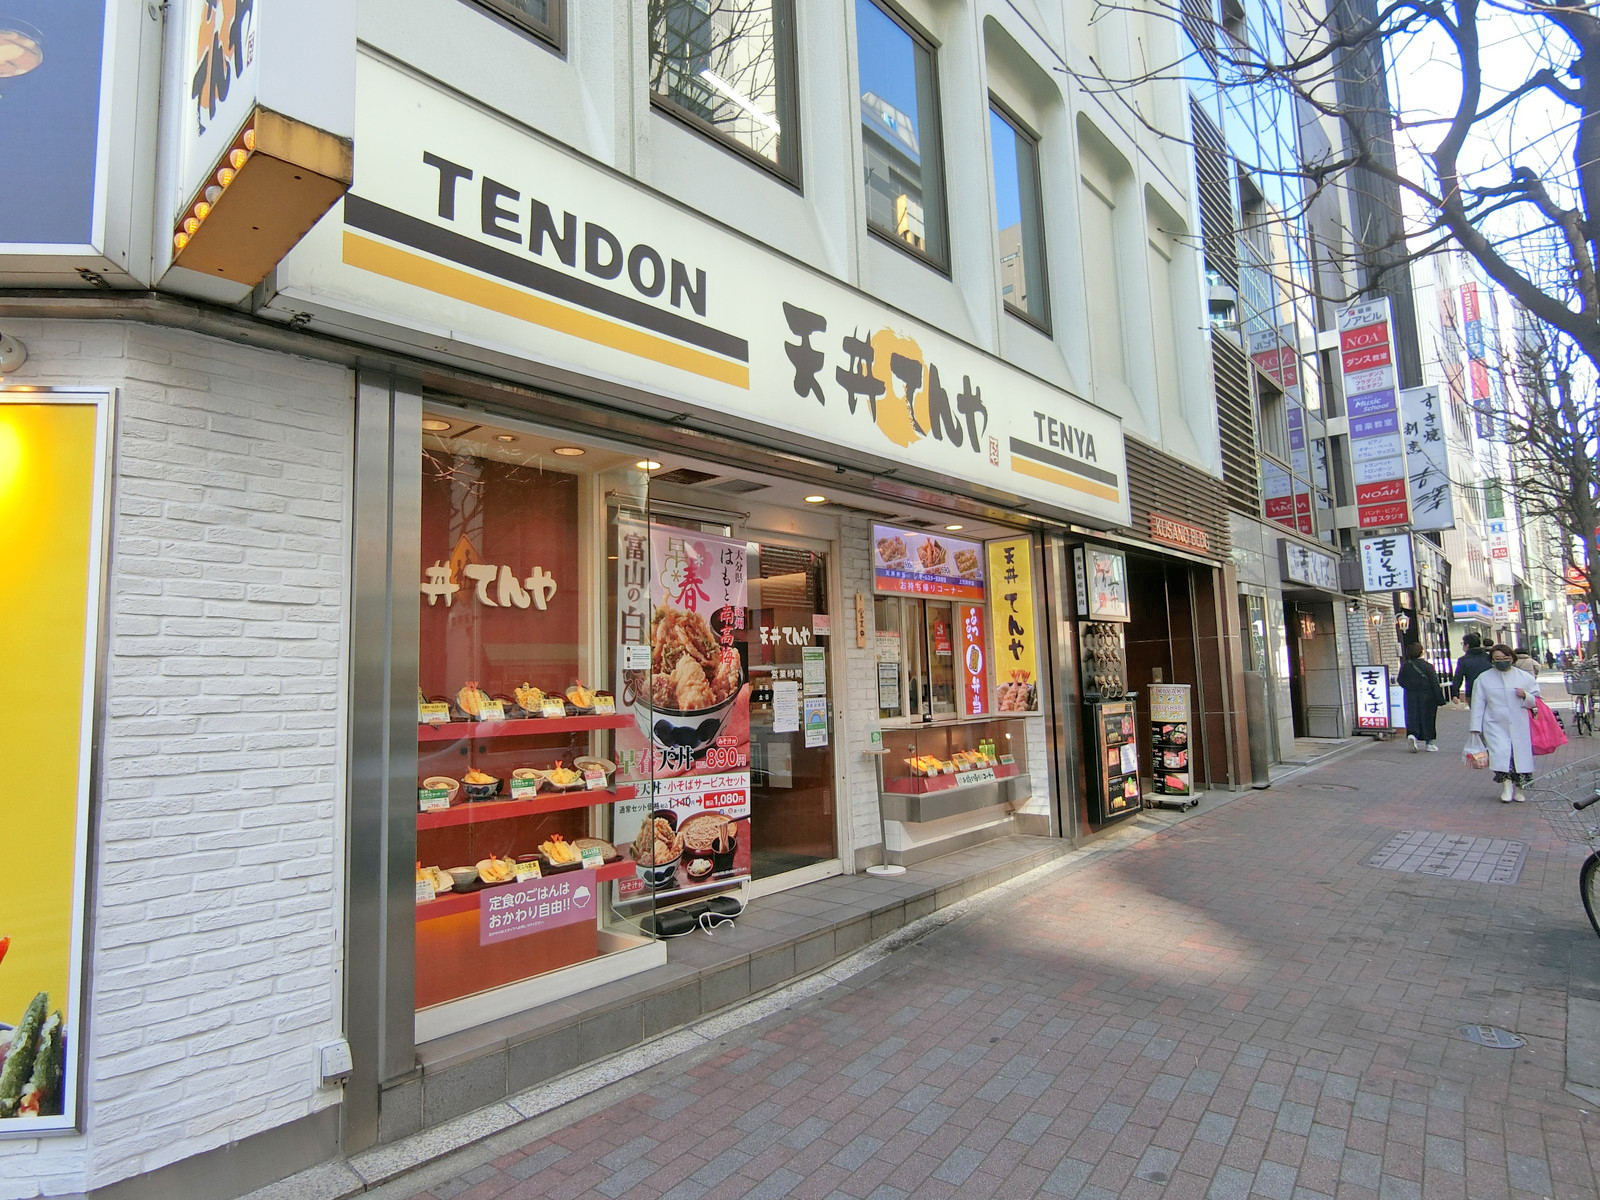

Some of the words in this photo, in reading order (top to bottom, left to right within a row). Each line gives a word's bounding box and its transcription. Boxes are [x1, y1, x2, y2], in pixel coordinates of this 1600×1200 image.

[423, 151, 707, 317] TENDON
[1343, 311, 1382, 328] ノアビル
[1346, 332, 1379, 349] NOA
[1346, 352, 1388, 367] ダンス教室
[1355, 397, 1382, 409] Music
[1363, 402, 1389, 413] School
[1033, 410, 1097, 463] TENYA
[1355, 418, 1394, 432] 音楽教室
[1155, 517, 1189, 544] KUSANO
[1363, 513, 1405, 524] 練習スタジオ
[719, 548, 735, 602] はもと
[1373, 539, 1402, 587] 吉そば
[899, 580, 964, 595] お持ち帰りコーナー
[719, 603, 736, 666] 南高梅
[971, 676, 984, 714] 弁当
[1361, 670, 1383, 714] 吉そば
[1361, 718, 1375, 727] 24
[619, 745, 695, 776] 早春天丼
[488, 881, 570, 912] 定食のごはんは
[488, 898, 571, 929] おかわり自由!!
